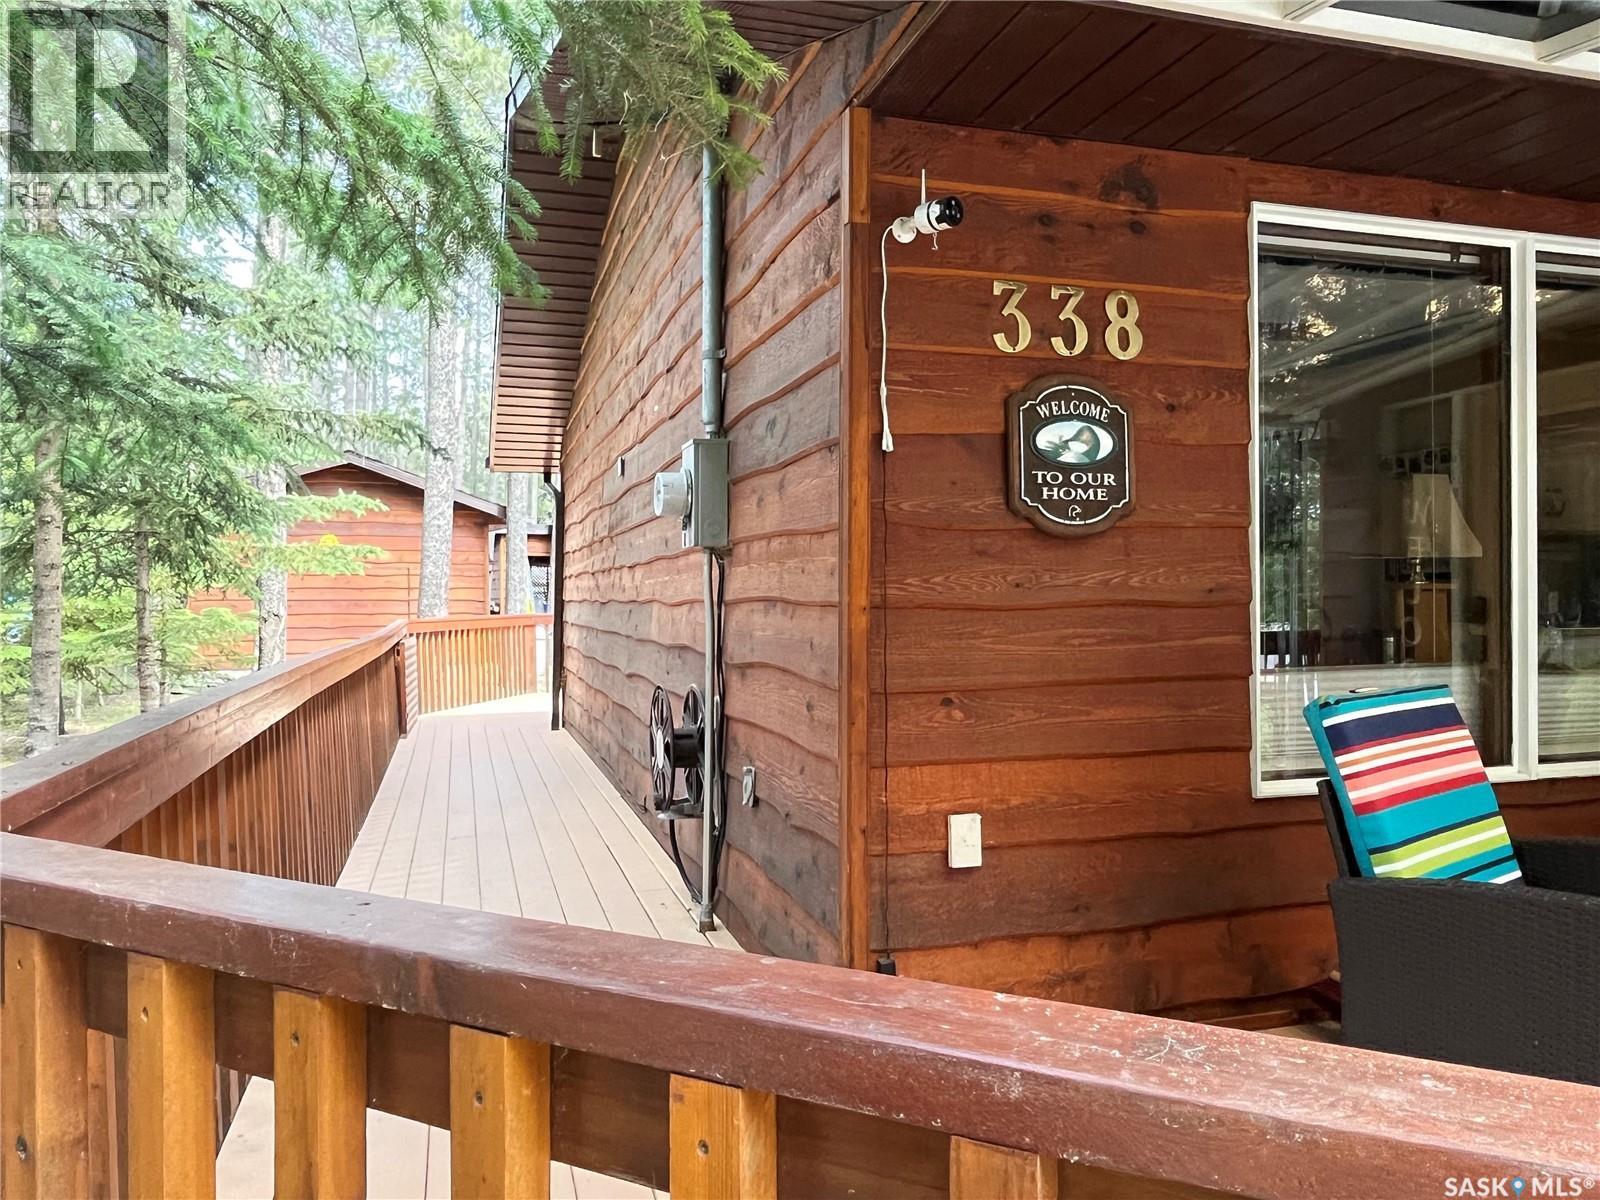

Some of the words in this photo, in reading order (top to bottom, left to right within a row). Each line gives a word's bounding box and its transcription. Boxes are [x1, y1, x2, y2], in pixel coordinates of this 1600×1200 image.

[993, 280, 1143, 360] 338
[1036, 400, 1110, 422] WELCOME
[1032, 471, 1063, 485] TO
[1070, 472, 1117, 486] OUR
[1042, 487, 1108, 501] HOME
